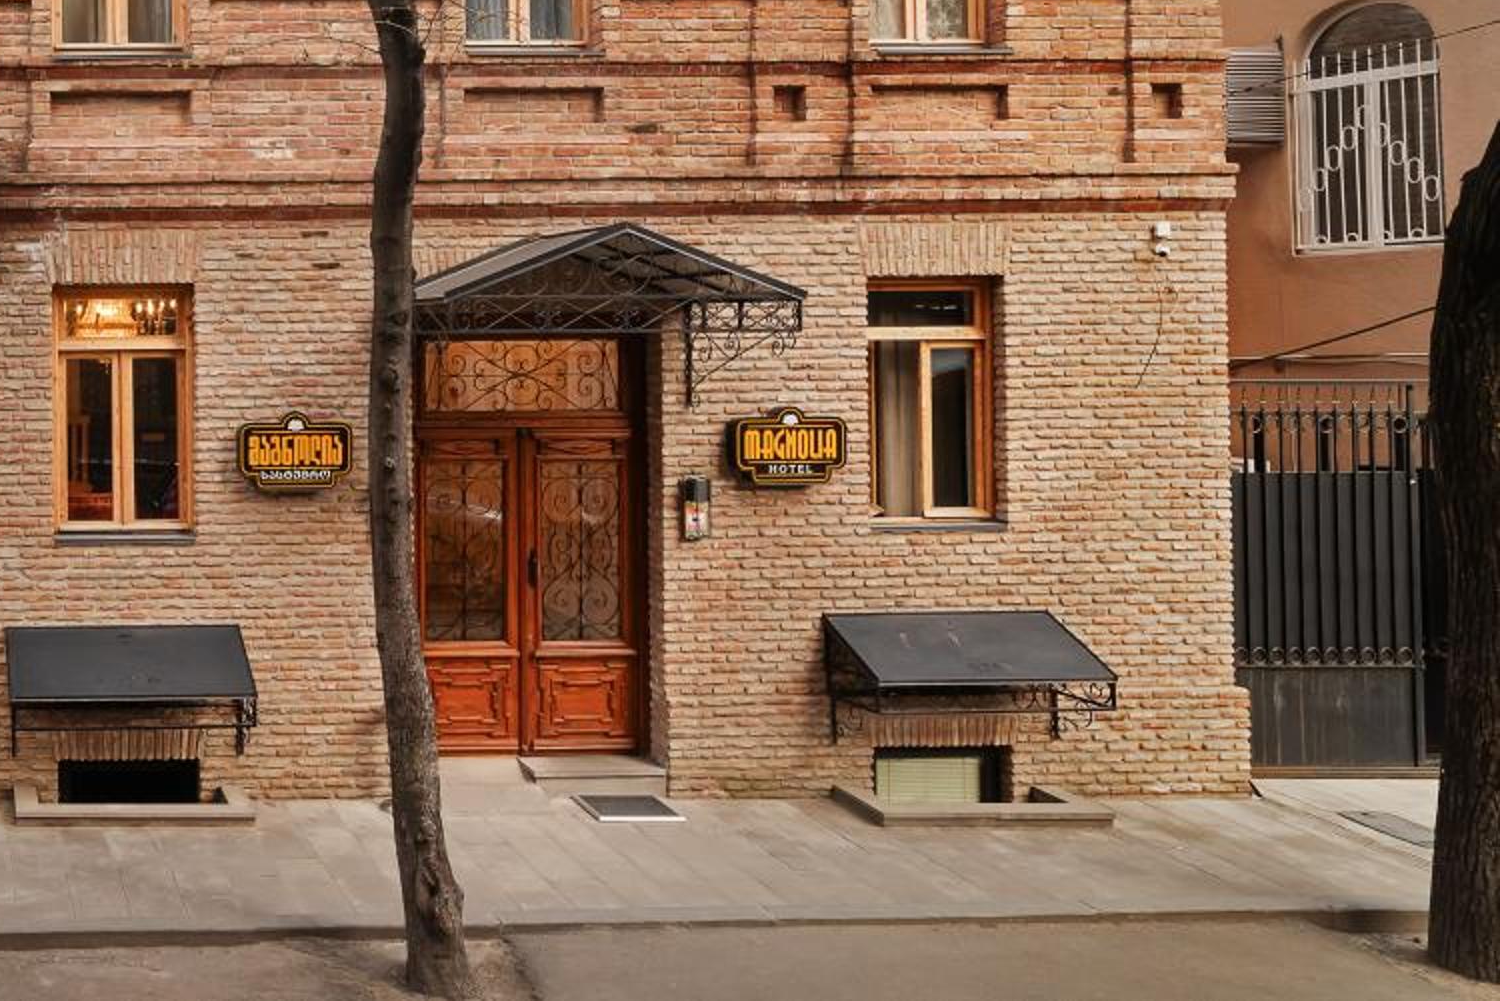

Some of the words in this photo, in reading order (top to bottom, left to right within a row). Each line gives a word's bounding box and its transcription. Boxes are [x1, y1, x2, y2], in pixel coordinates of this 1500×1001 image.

[248, 435, 342, 466] მაგნოლია
[744, 429, 837, 459] MAGNOLIA
[261, 471, 331, 480] სასტუმრო
[768, 465, 812, 474] HOTEL
